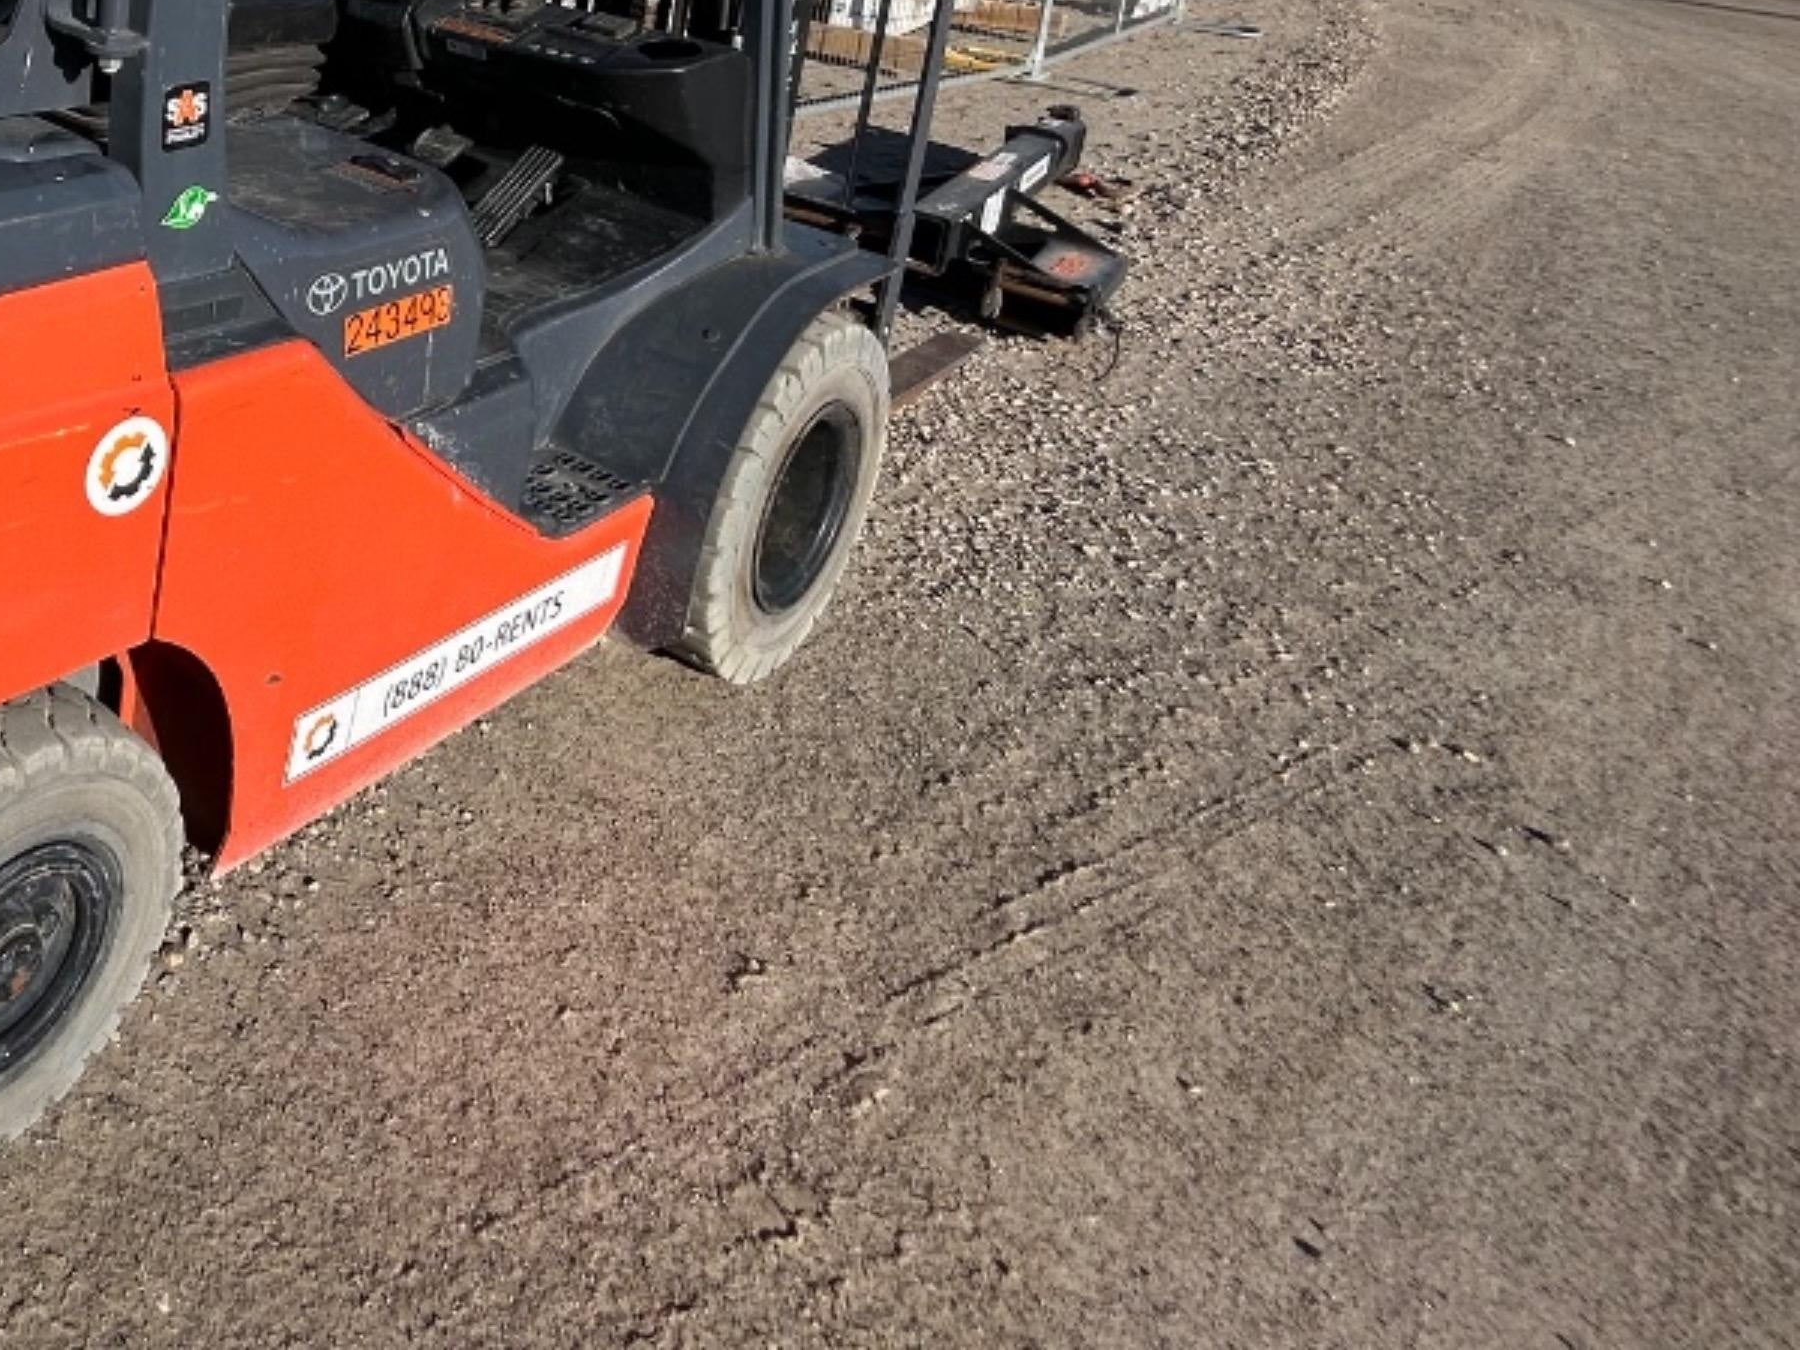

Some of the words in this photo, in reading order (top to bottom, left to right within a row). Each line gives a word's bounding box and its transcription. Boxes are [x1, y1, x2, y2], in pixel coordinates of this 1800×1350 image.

[351, 247, 449, 299] TOYOTA
[383, 656, 449, 718] (888)
[454, 590, 565, 674] 80-RENTS
